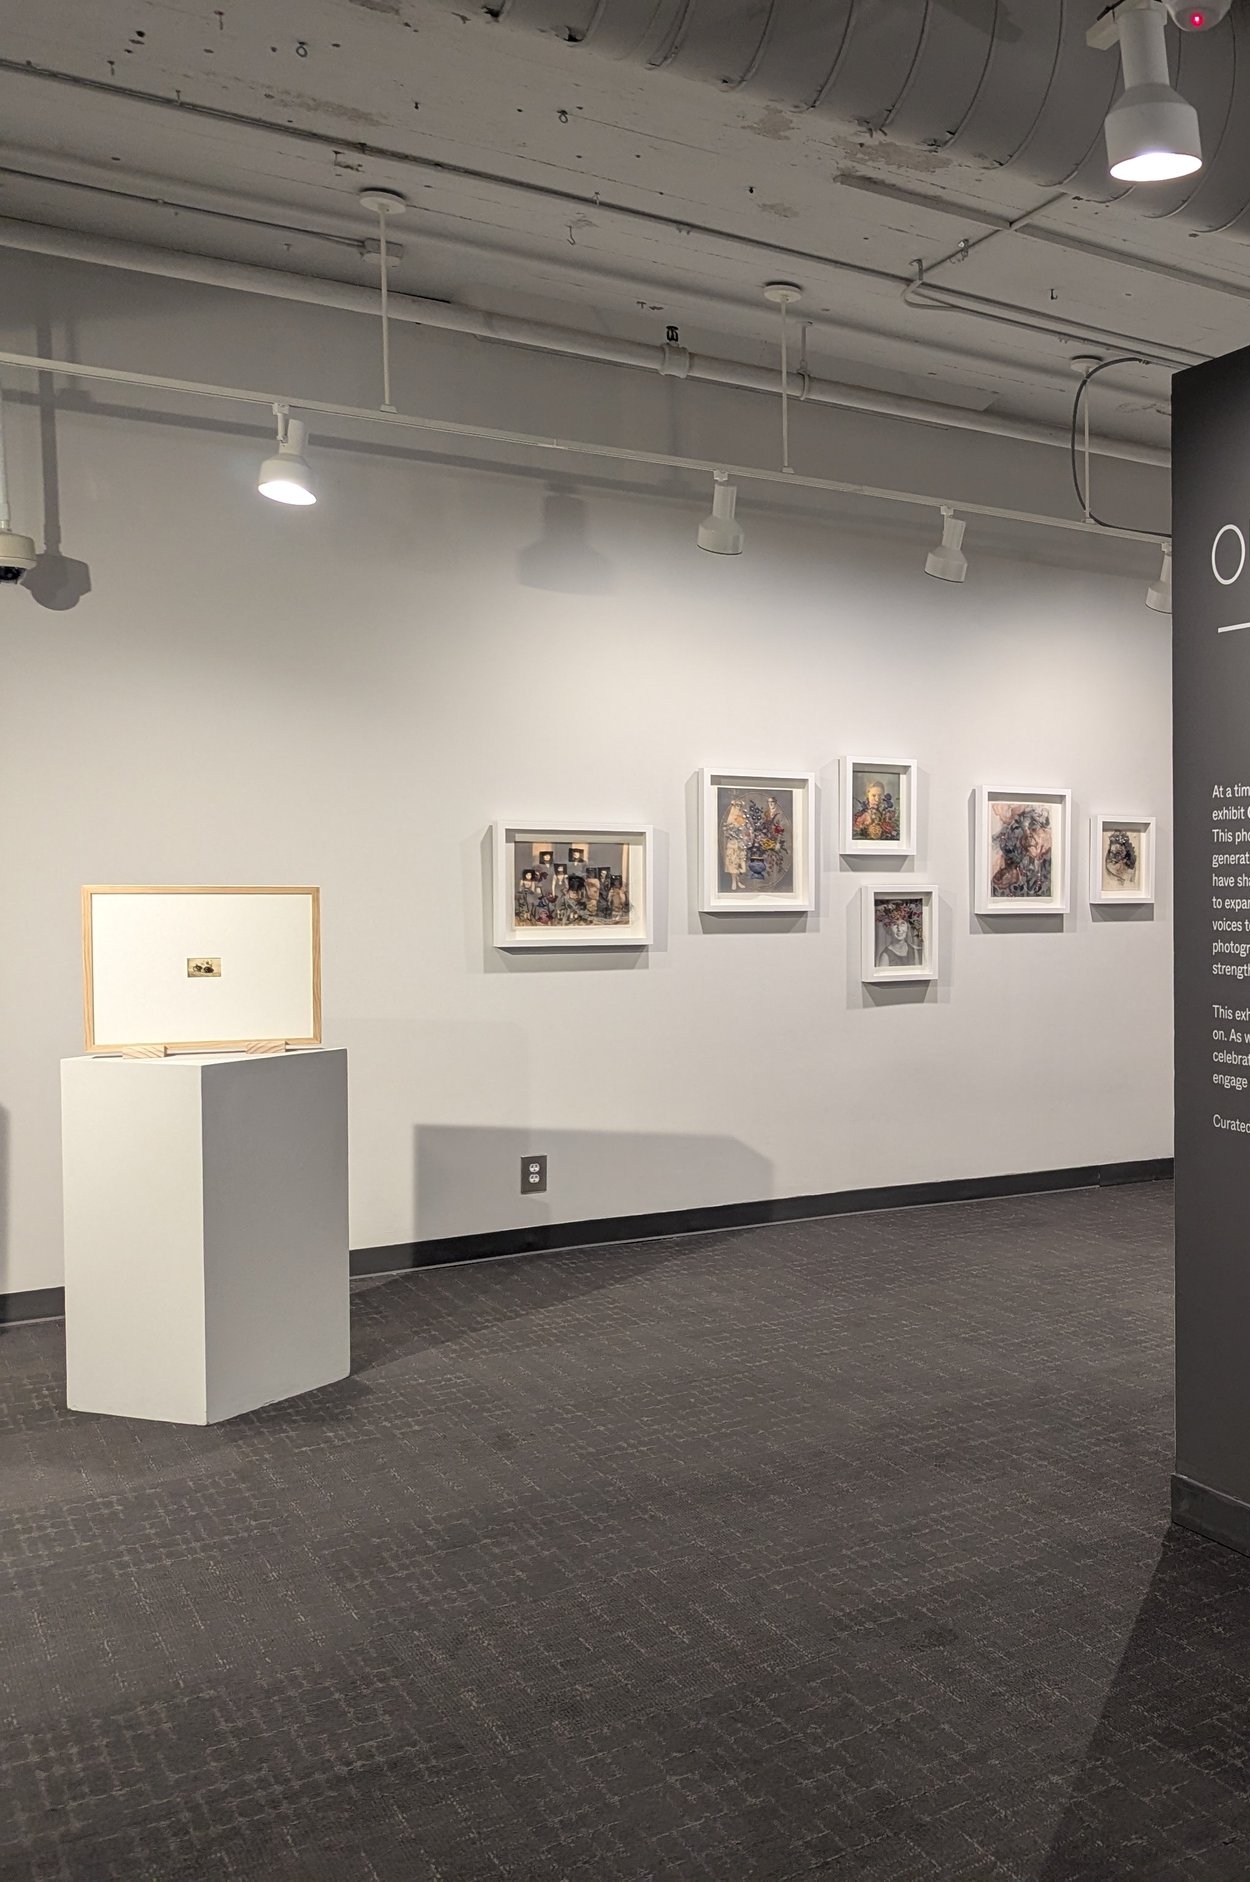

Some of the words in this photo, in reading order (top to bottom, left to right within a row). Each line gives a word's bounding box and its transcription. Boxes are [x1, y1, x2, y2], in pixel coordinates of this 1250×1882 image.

[1213, 785, 1224, 798] At
[1226, 787, 1232, 797] a
[1213, 807, 1245, 820] exhibit
[1212, 829, 1233, 842] This
[1212, 897, 1222, 908] to
[1213, 1030, 1227, 1040] on.
[1229, 1029, 1242, 1043] As
